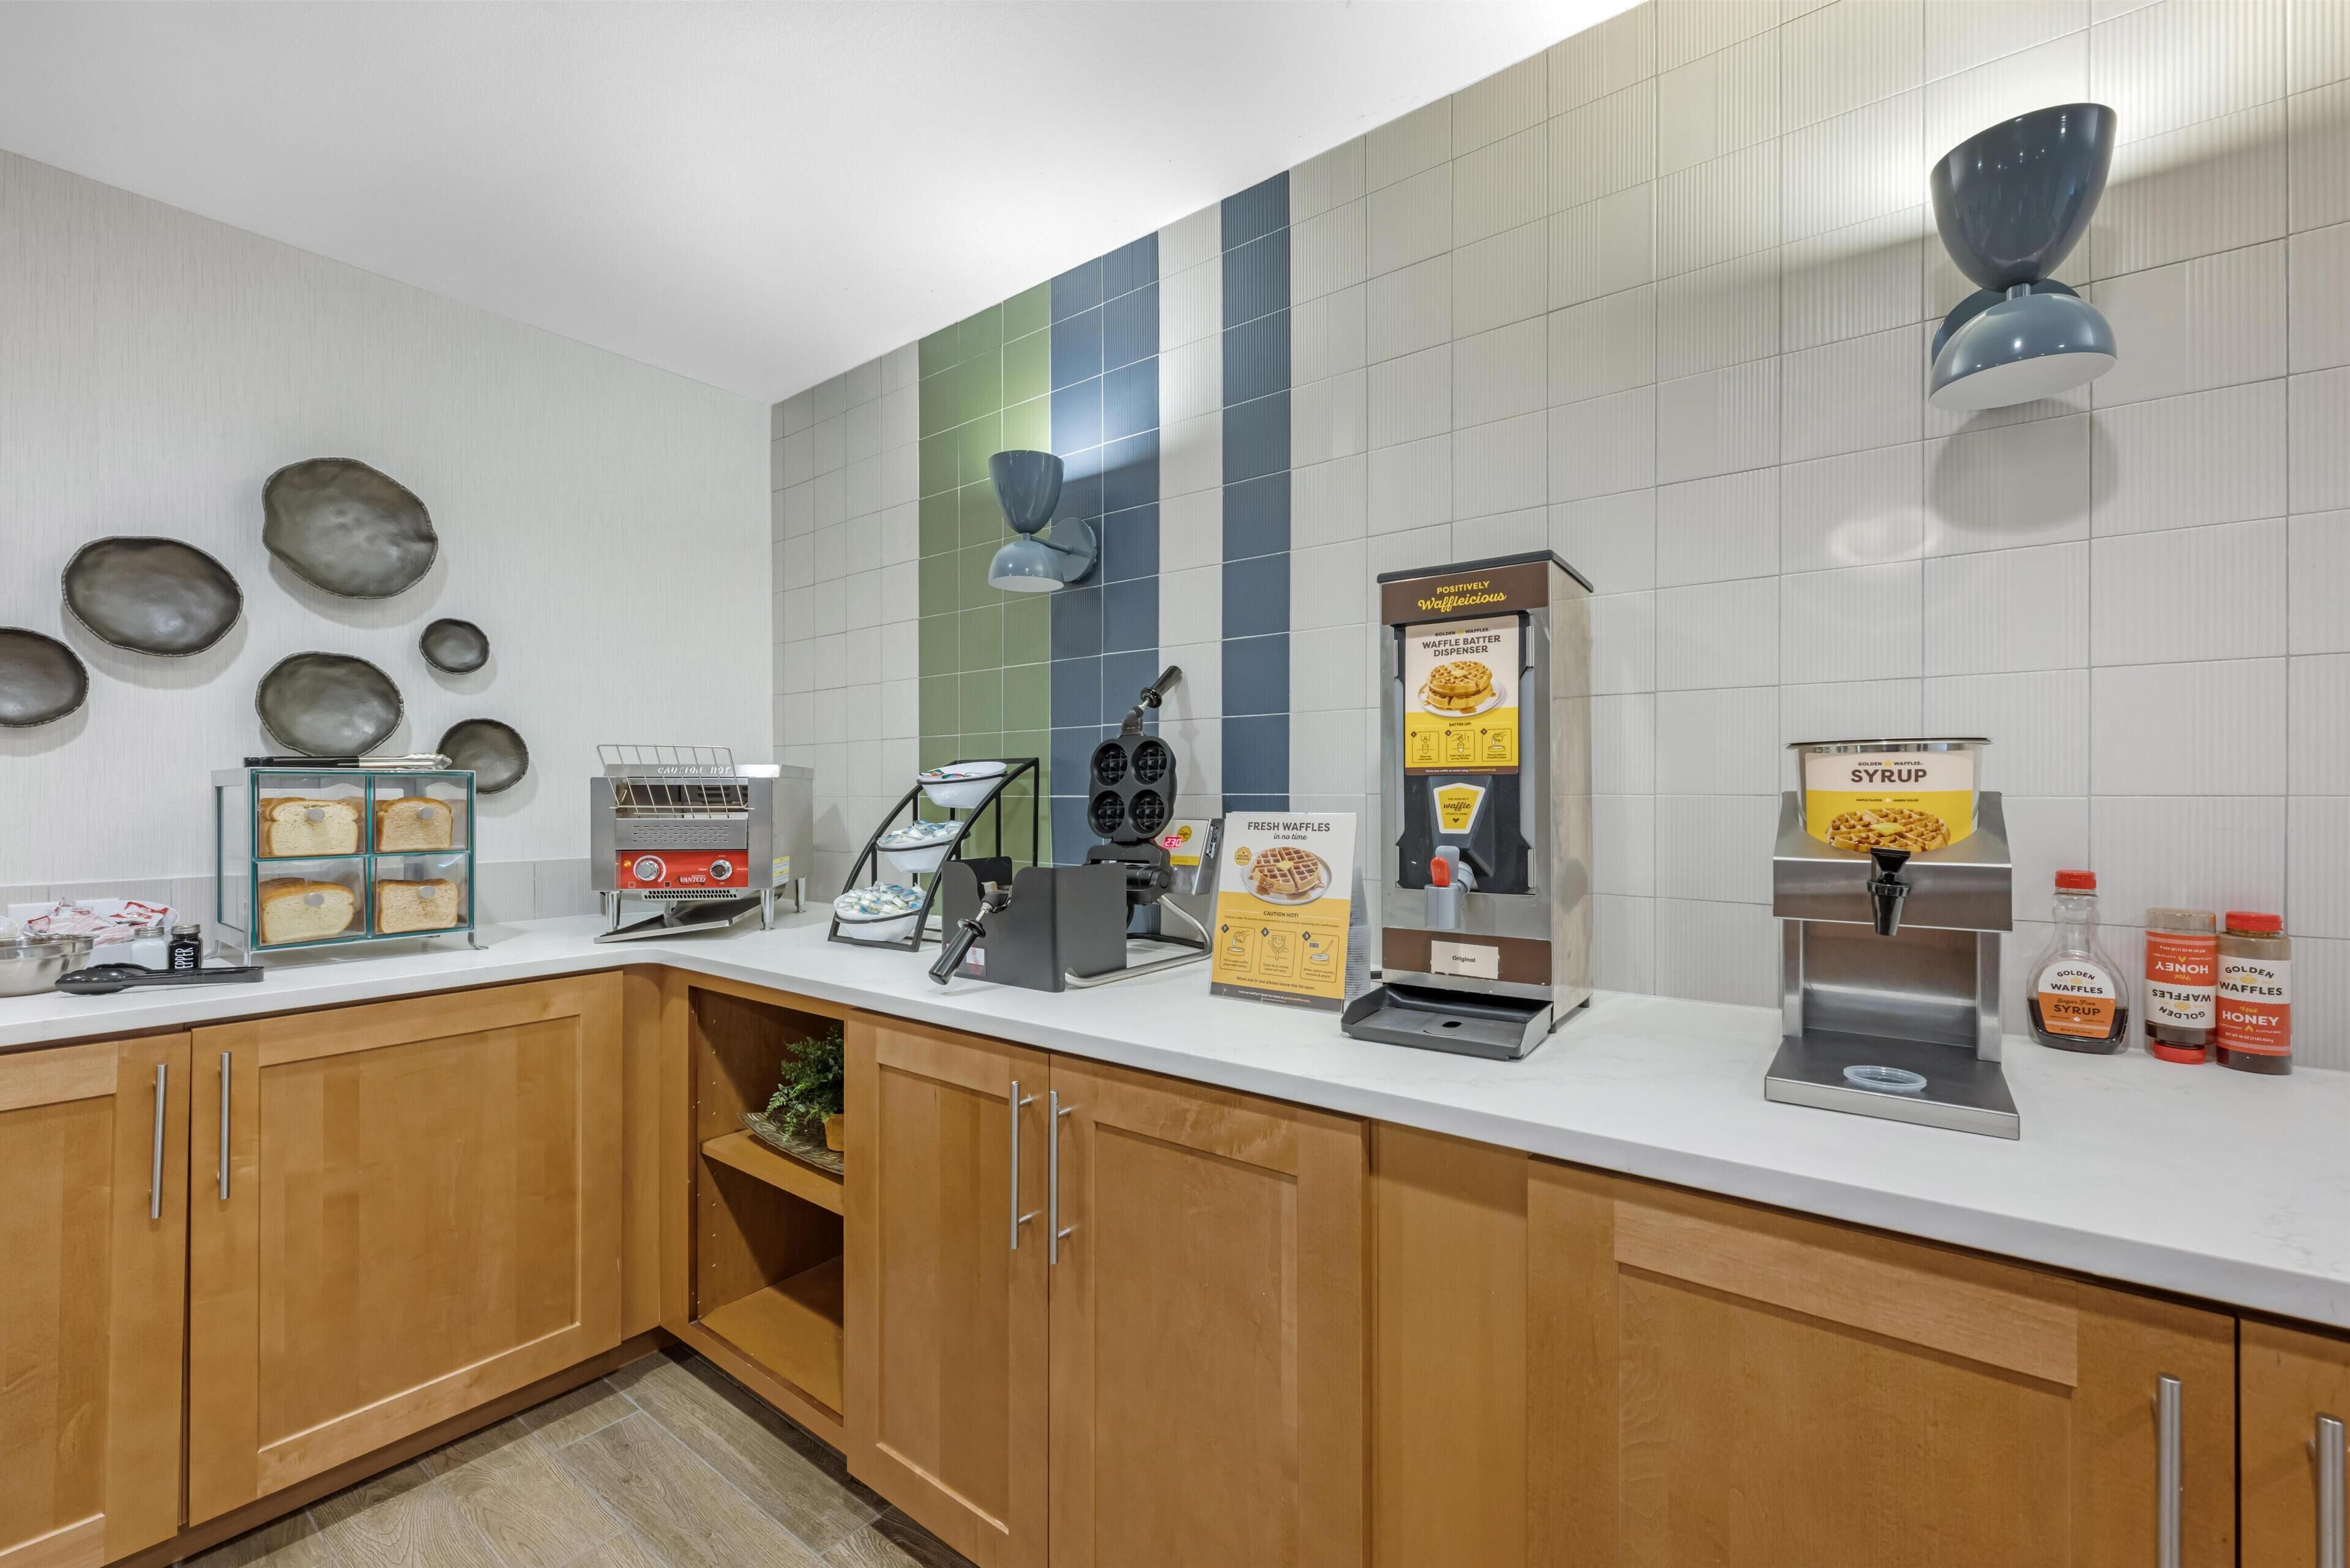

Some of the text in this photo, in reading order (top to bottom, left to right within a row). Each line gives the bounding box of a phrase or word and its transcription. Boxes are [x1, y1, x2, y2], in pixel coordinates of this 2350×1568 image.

[1437, 581, 1490, 594] POSITIVELY
[1417, 592, 1507, 612] Waffleicious
[1422, 635, 1501, 649] WAFFLE BATTER
[1433, 645, 1488, 657] DISPENSER
[1851, 769, 1927, 783] SYRUP
[1443, 802, 1471, 812] waffle
[1247, 821, 1330, 832] FRESH WAFFLES
[174, 947, 194, 969] EPPER
[2155, 961, 2209, 974] HONEY
[2225, 966, 2274, 979] GOLDEN
[2057, 970, 2095, 980] GOLDEN
[2051, 983, 2103, 995] WAFFLES
[2219, 980, 2282, 996] WAFFLES
[2152, 988, 2211, 1002] WAFFLES
[2054, 1004, 2101, 1016] SYRUP
[2159, 1006, 2206, 1020] GOLDEN
[2222, 1010, 2280, 1026] HONEY
